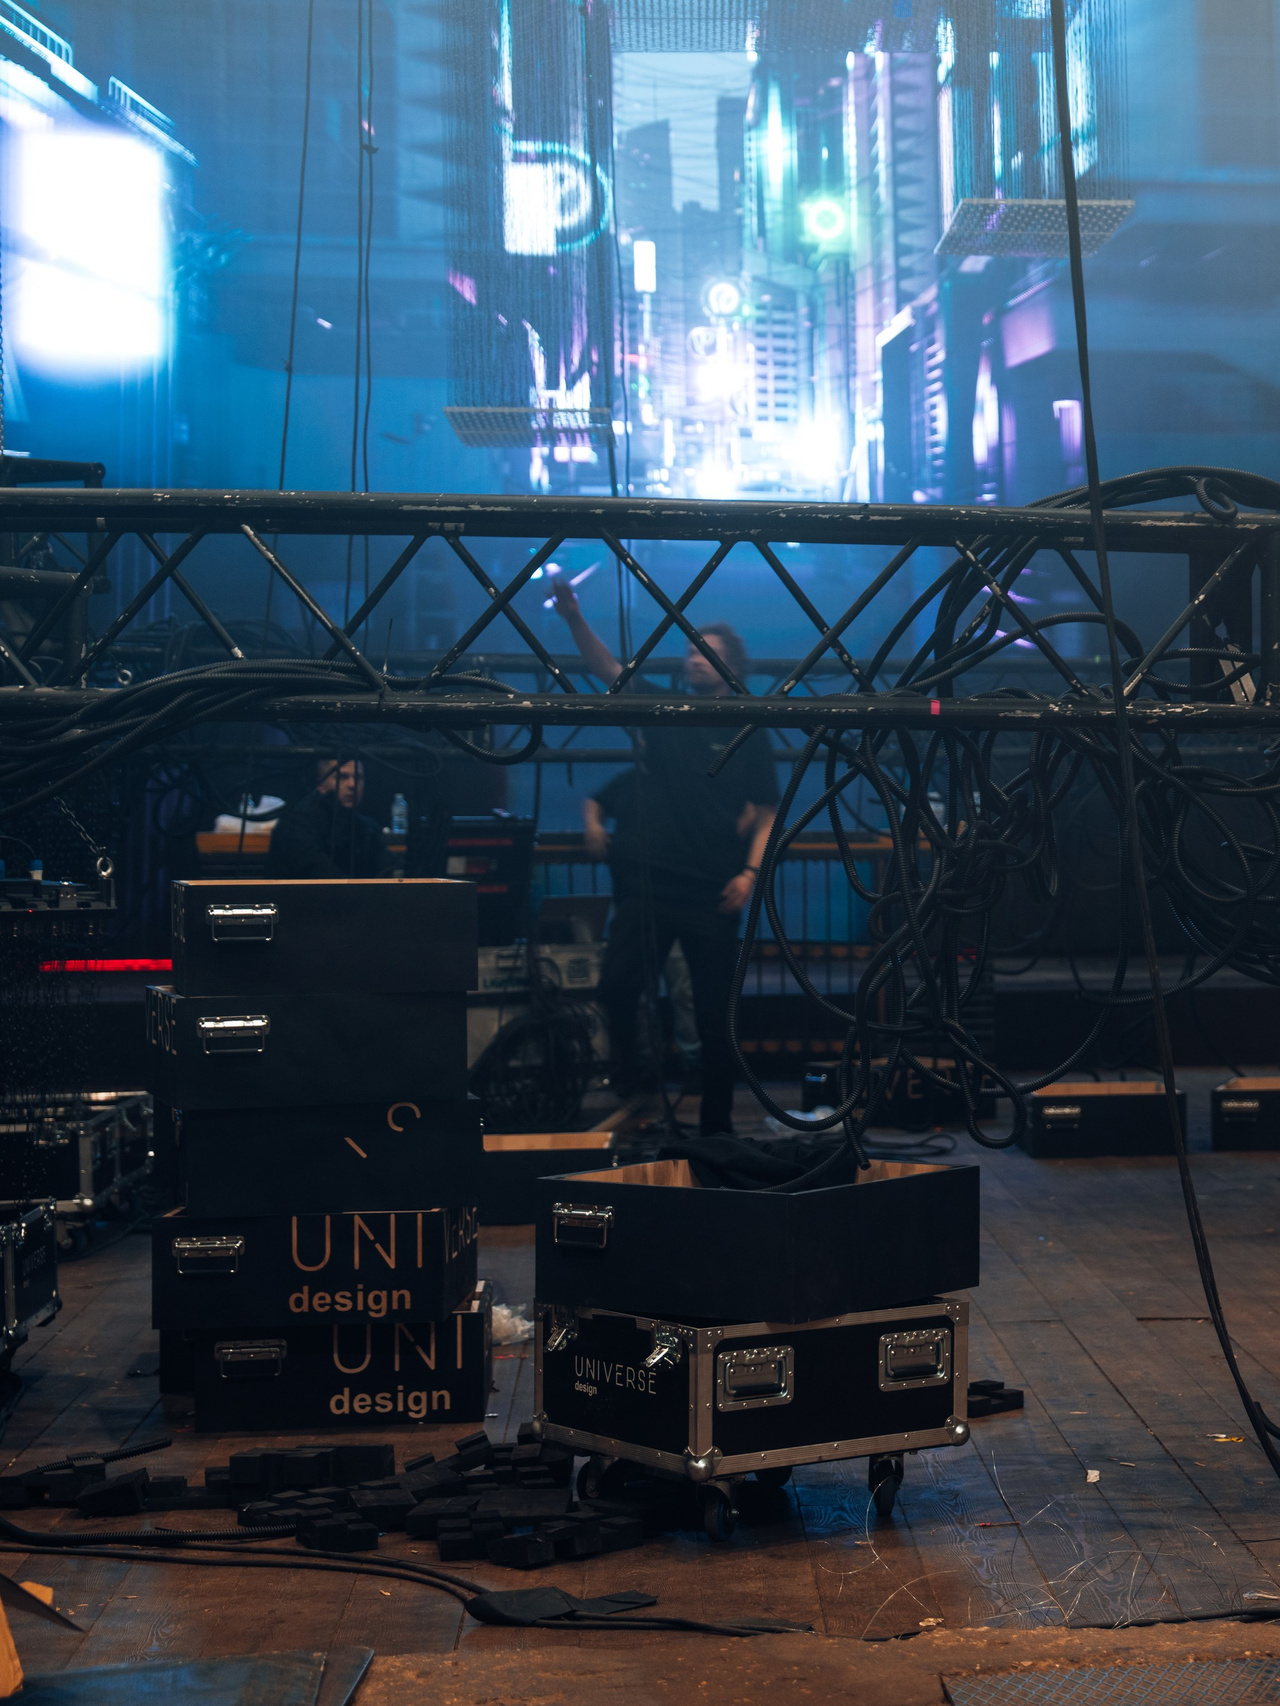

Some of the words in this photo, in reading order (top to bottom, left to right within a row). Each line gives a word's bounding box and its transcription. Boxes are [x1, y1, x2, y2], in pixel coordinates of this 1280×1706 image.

[290, 1212, 424, 1273] UNI
[288, 1283, 412, 1319] design
[332, 1313, 463, 1375] UNI
[573, 1379, 599, 1397] design
[574, 1354, 658, 1396] UNIVERSE
[328, 1384, 452, 1419] design
